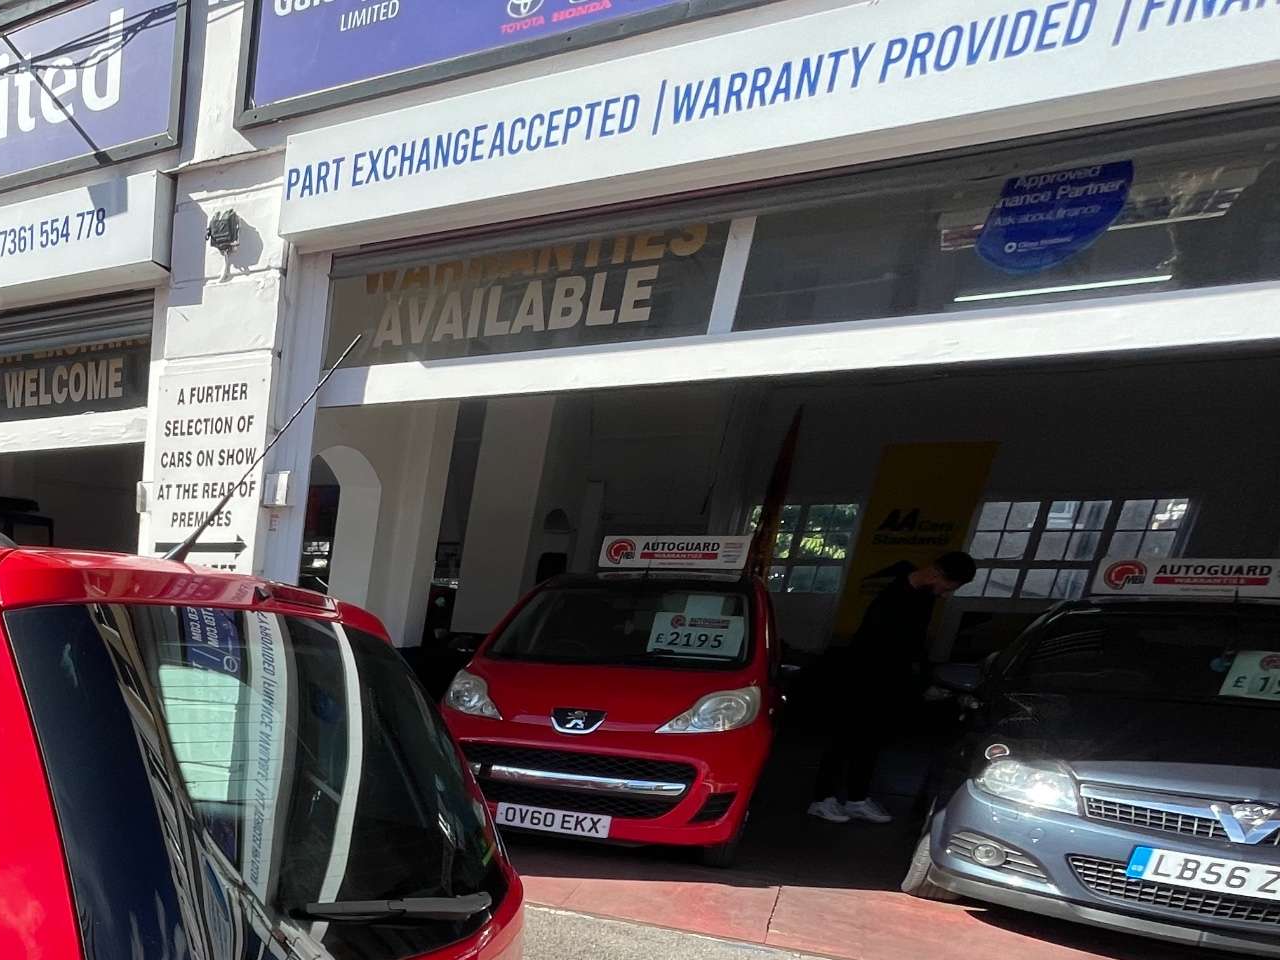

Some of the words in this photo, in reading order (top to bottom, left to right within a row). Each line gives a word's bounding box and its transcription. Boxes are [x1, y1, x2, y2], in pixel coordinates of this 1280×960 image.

[339, 0, 400, 32] LIMITED
[501, 15, 545, 33] TOYOTA
[552, 0, 612, 22] HONDA
[286, 157, 346, 200] PART
[673, 42, 876, 125] WARRANTY
[878, 0, 1098, 83] PROVIDED
[1056, 180, 1126, 200] Partner
[39, 215, 70, 248] 554
[76, 207, 106, 241] 778
[372, 265, 659, 348] AVAILABLE
[5, 357, 124, 409] WELCOME
[177, 388, 186, 405] A
[189, 382, 248, 404] FURTHER
[164, 415, 233, 437] SELECTION
[237, 415, 255, 433] OF
[160, 450, 192, 469] CARS
[196, 449, 213, 466] ON
[218, 447, 257, 465] SHOW
[157, 482, 173, 501] AT
[176, 482, 198, 499] THE
[202, 481, 234, 498] REAR
[239, 480, 256, 497] OF
[642, 541, 720, 552] AUTOGUARD
[1156, 564, 1273, 577] AUTOGUARD
[504, 806, 554, 828] OV60
[560, 815, 602, 834] EKX
[1151, 854, 1251, 889] LB56
